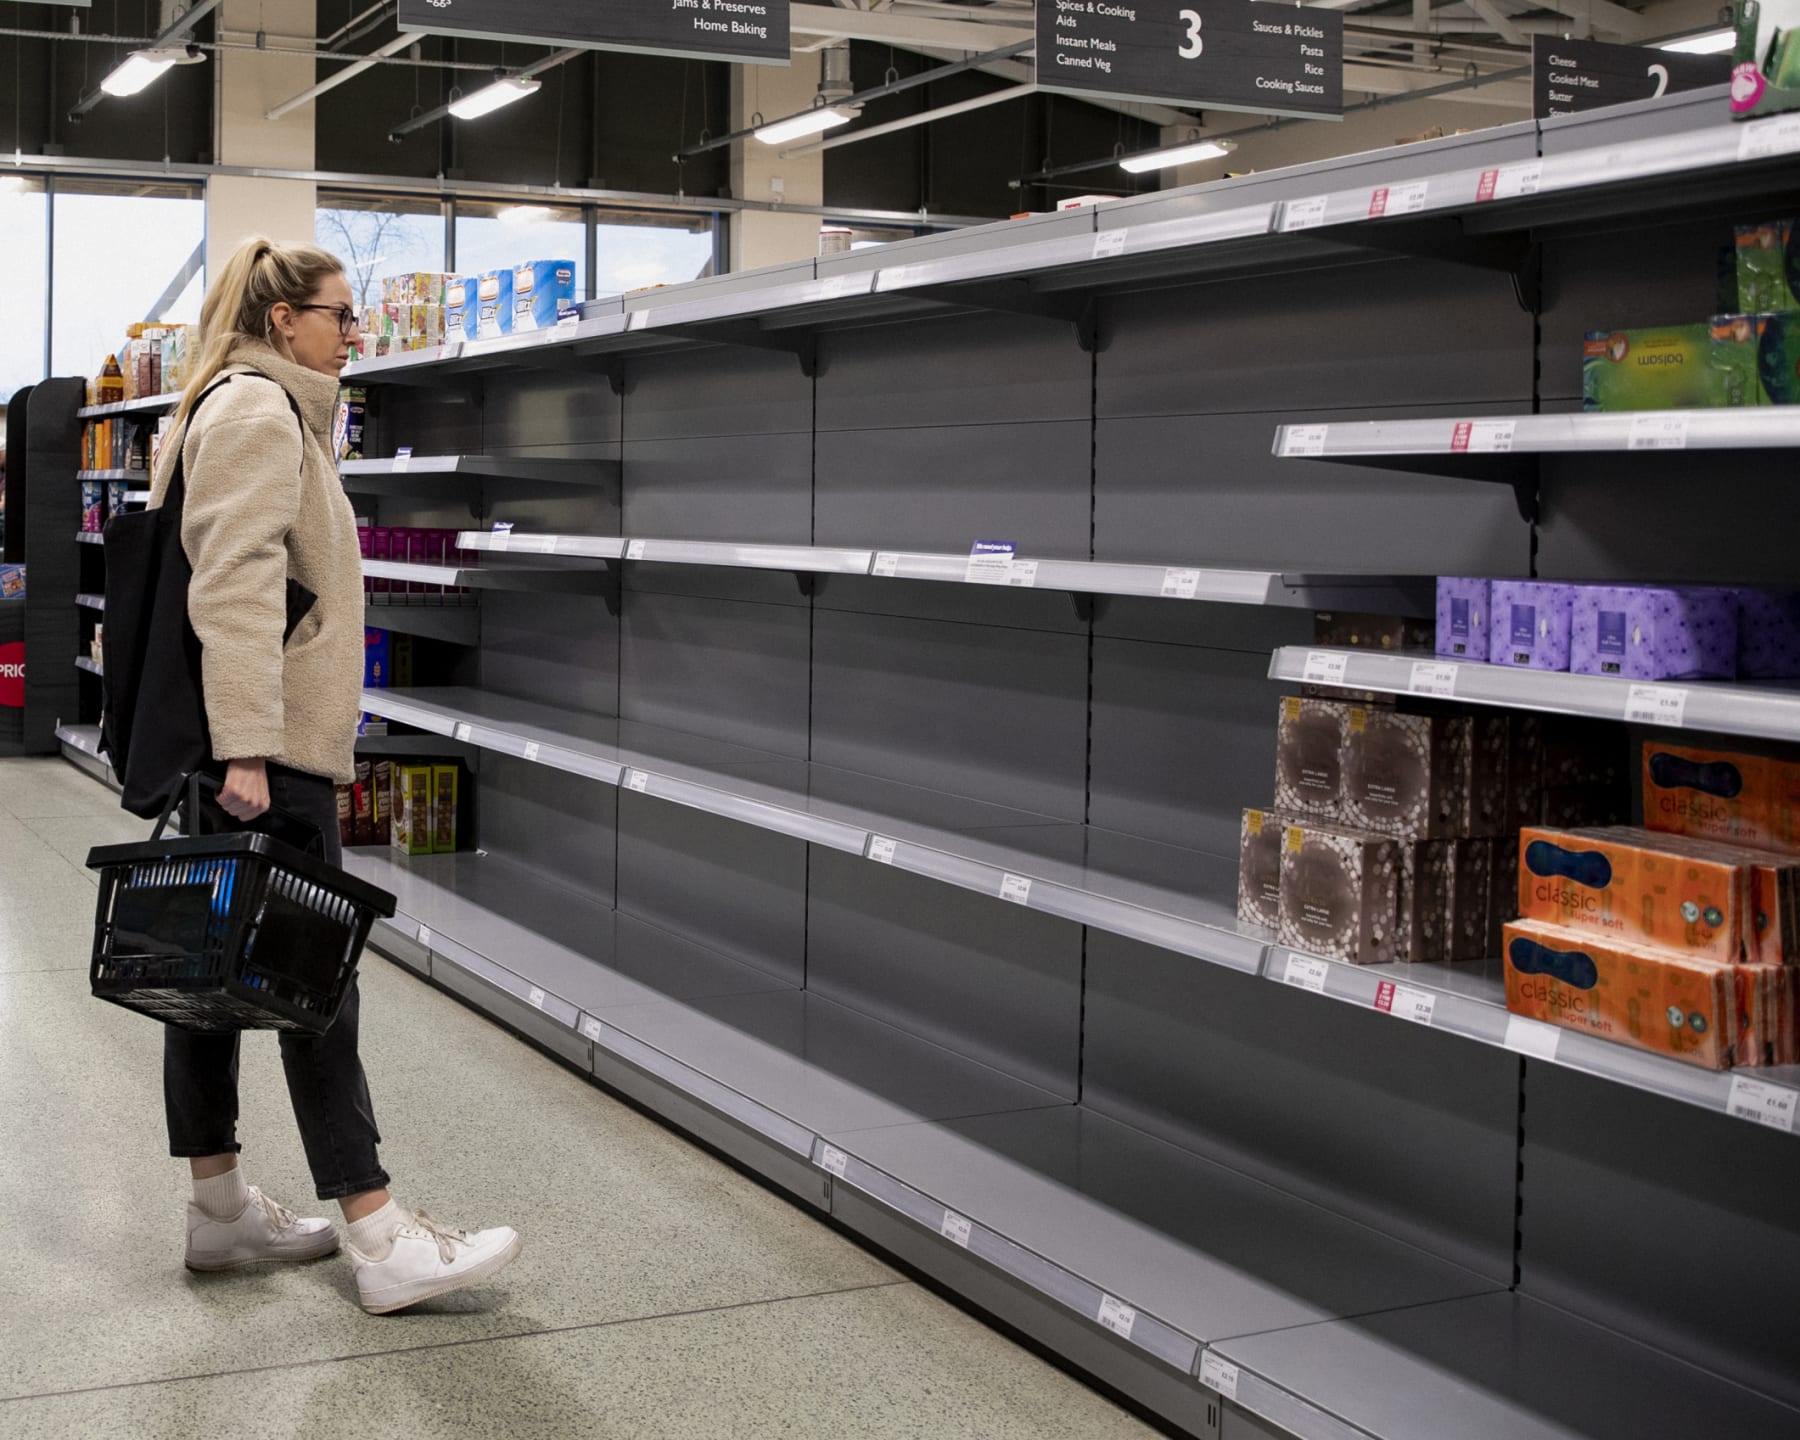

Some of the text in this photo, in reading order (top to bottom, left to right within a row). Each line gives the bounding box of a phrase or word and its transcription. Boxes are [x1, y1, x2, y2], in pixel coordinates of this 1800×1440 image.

[425, 0, 452, 8] ggs
[672, 0, 767, 15] Jams & Preserves
[1056, 0, 1136, 21] Spices & Cooking
[693, 17, 767, 39] Home Baking
[1056, 14, 1077, 28] Aids
[1252, 20, 1324, 39] Sauces & Pickles
[1056, 34, 1117, 52] Instant Meals
[1178, 9, 1204, 59] 3
[1300, 44, 1324, 57] Pasta
[1056, 53, 1112, 73] Canned Veg
[1304, 63, 1324, 75] Rice
[1549, 55, 1577, 69] Cheese
[1255, 76, 1324, 94] Cooking Sauces
[1549, 72, 1579, 86] Cooked
[1647, 64, 1669, 99] 2
[1637, 352, 1684, 366] balsam
[1660, 794, 1728, 822] classic
[1535, 882, 1597, 912] classic
[1602, 917, 1625, 930] soft
[1520, 979, 1585, 1013] classic
[1590, 1019, 1613, 1033] soft
